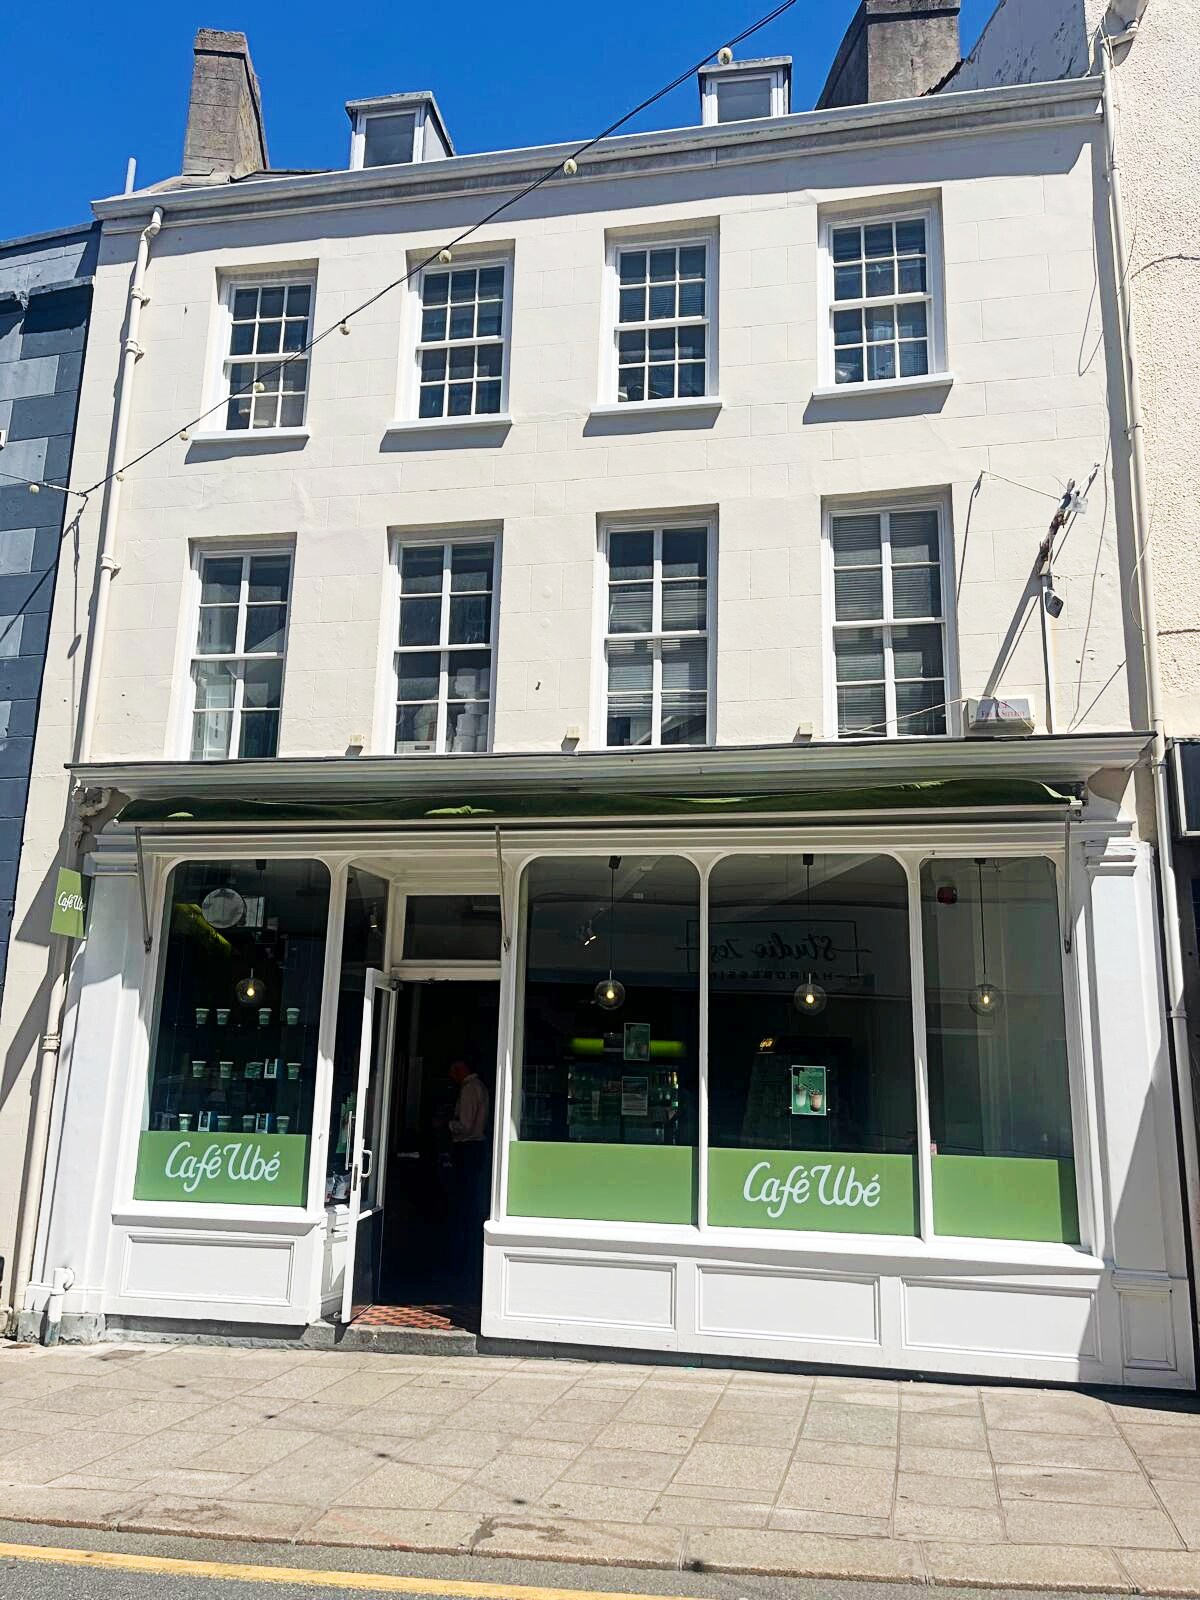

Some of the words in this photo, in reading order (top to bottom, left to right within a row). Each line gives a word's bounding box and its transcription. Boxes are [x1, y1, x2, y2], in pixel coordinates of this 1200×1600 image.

[57, 890, 73, 912] Café
[165, 1141, 221, 1193] Café
[223, 1143, 281, 1182] Ubé
[743, 1161, 810, 1218] Café
[810, 1164, 881, 1208] Ubé
